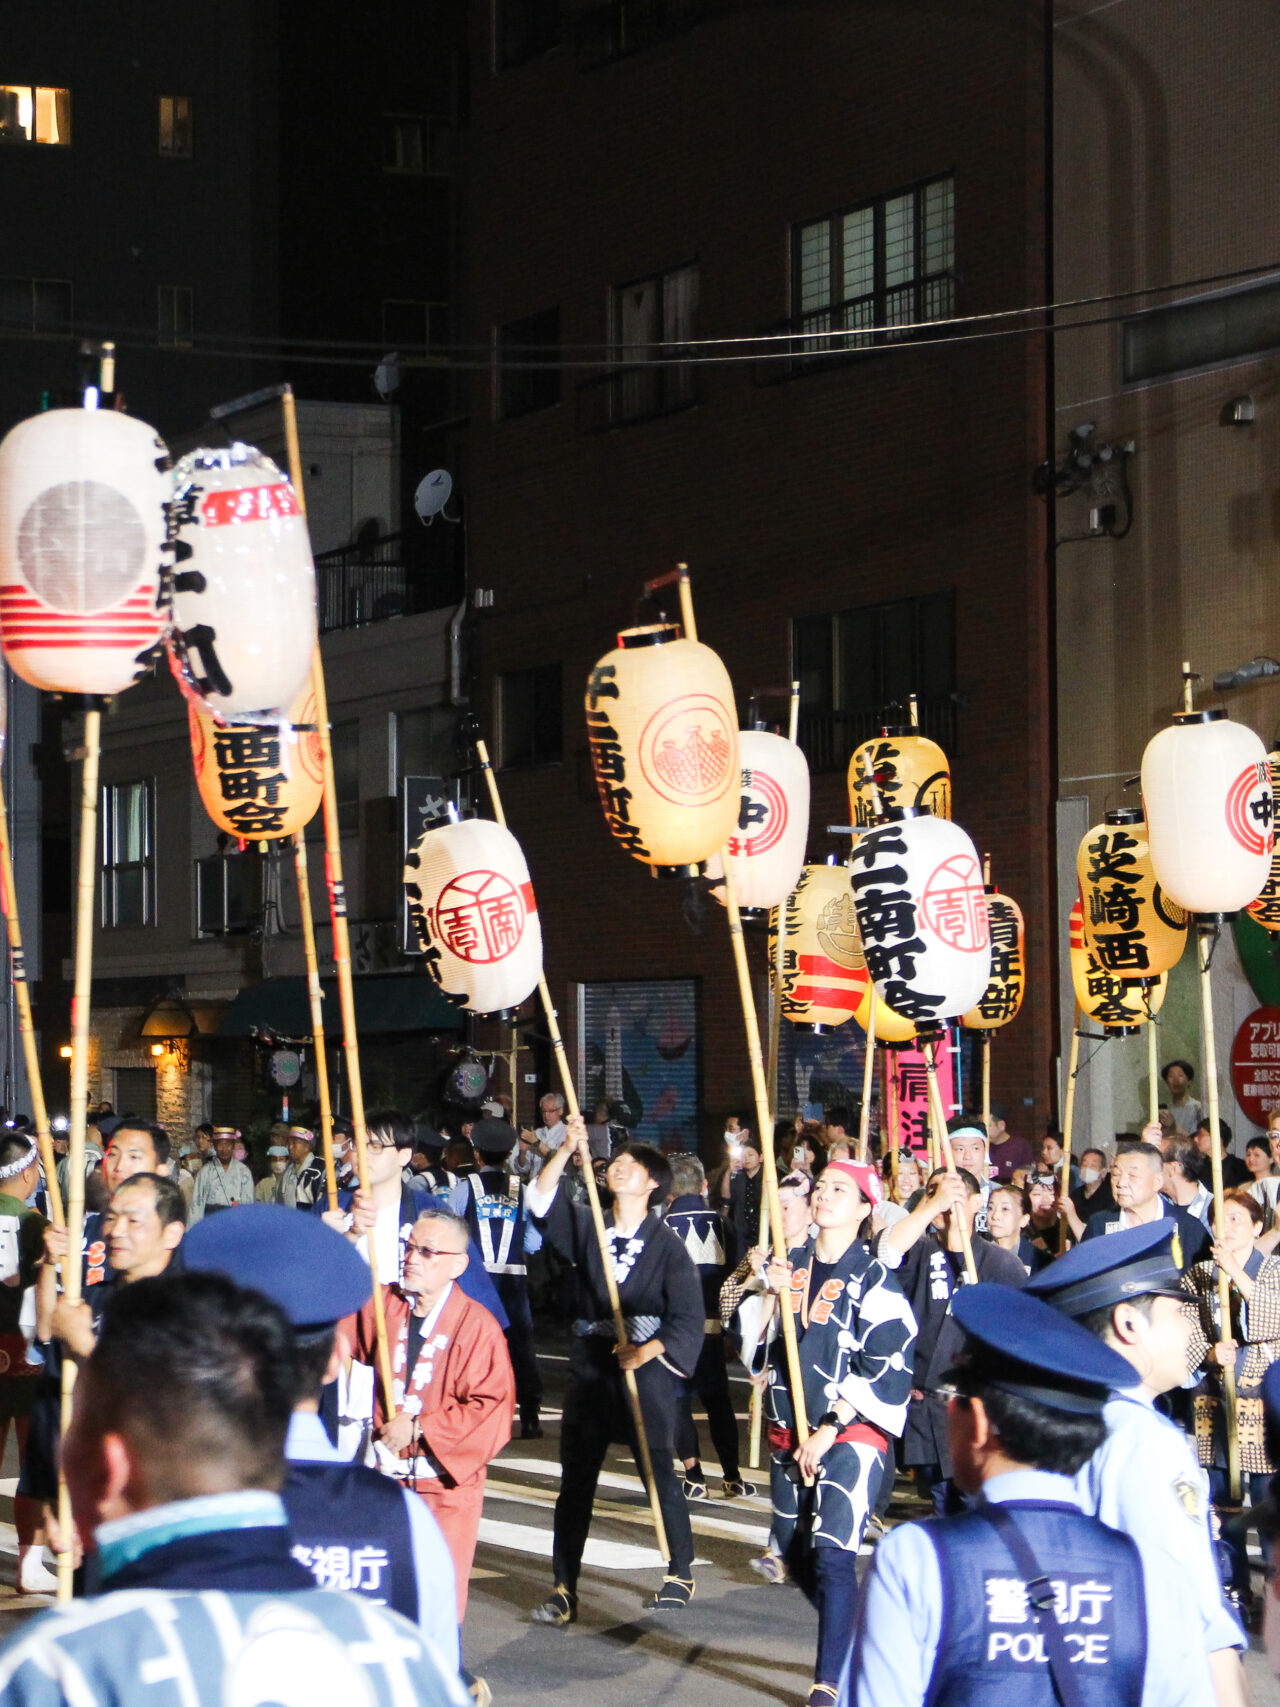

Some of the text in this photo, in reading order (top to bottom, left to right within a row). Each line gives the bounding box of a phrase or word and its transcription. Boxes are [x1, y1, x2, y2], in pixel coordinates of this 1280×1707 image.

[851, 826, 947, 1019] 千一南町会
[1086, 831, 1152, 970] 芝崎西
[979, 901, 1021, 1021] 青年部
[1085, 953, 1143, 1023] 町会
[987, 1632, 1111, 1664] POLCE
